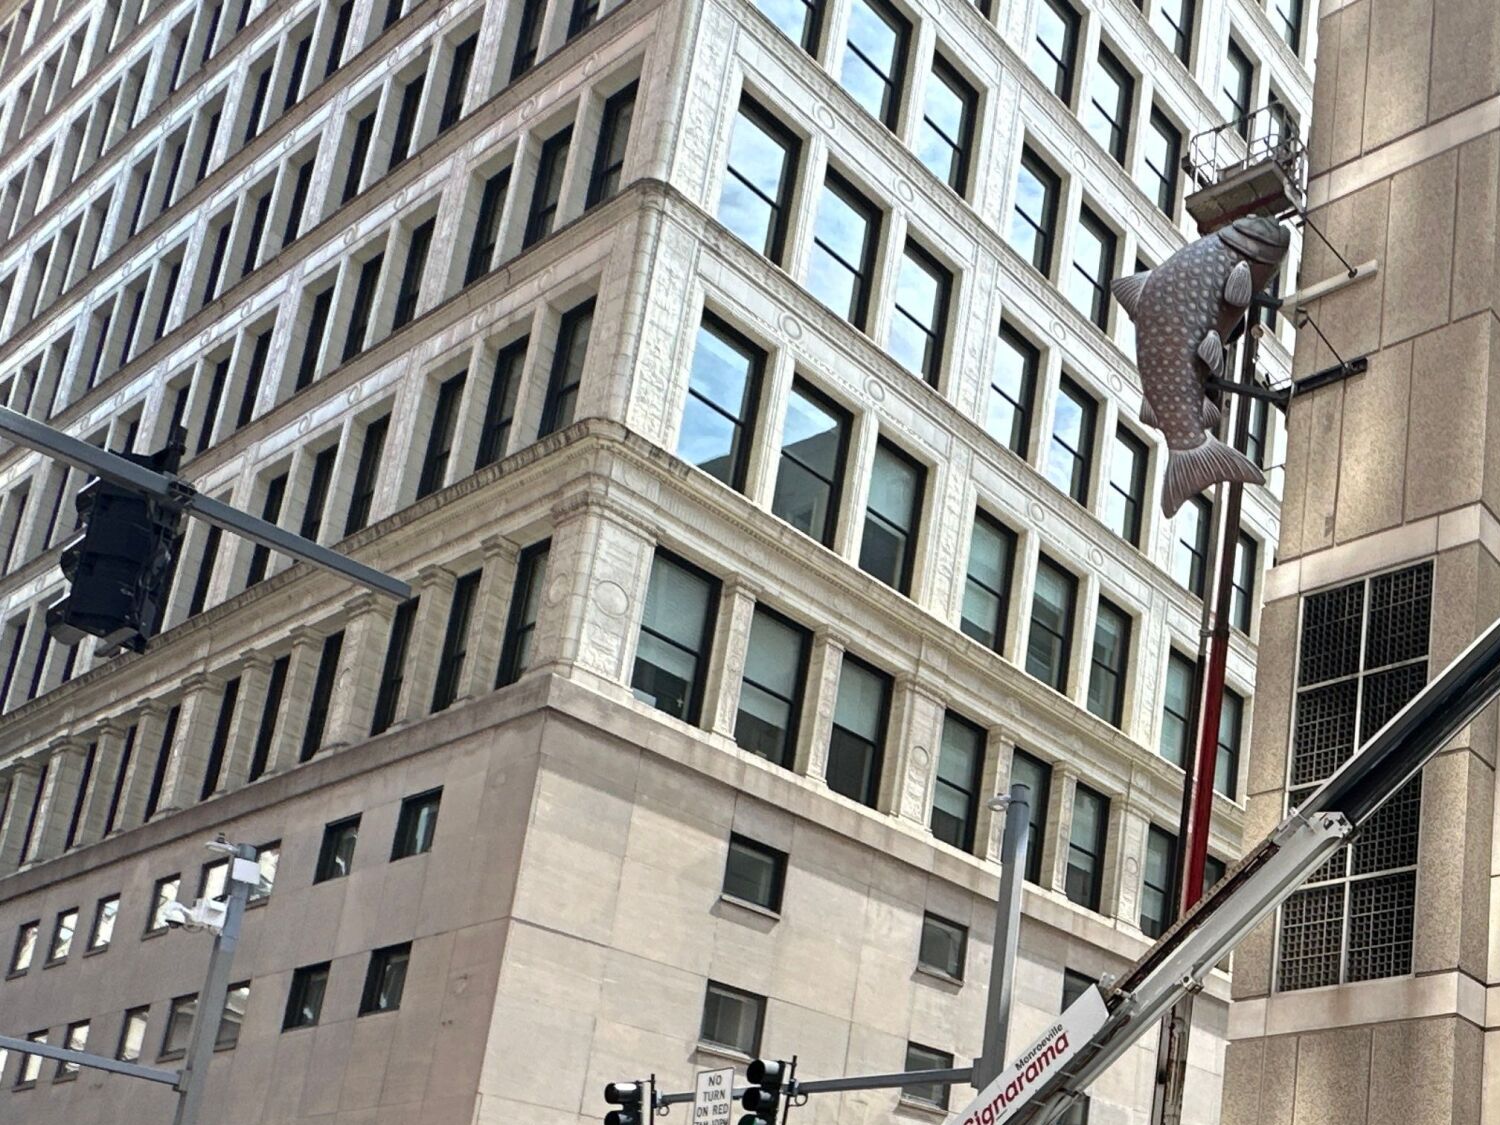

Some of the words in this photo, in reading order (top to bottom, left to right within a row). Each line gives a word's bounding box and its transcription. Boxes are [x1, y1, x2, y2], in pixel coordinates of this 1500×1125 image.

[1015, 1023, 1063, 1071] Monroeville
[708, 1075, 722, 1086] NO
[703, 1090, 726, 1102] TURN
[697, 1106, 708, 1117] ON
[712, 1103, 729, 1115] RED
